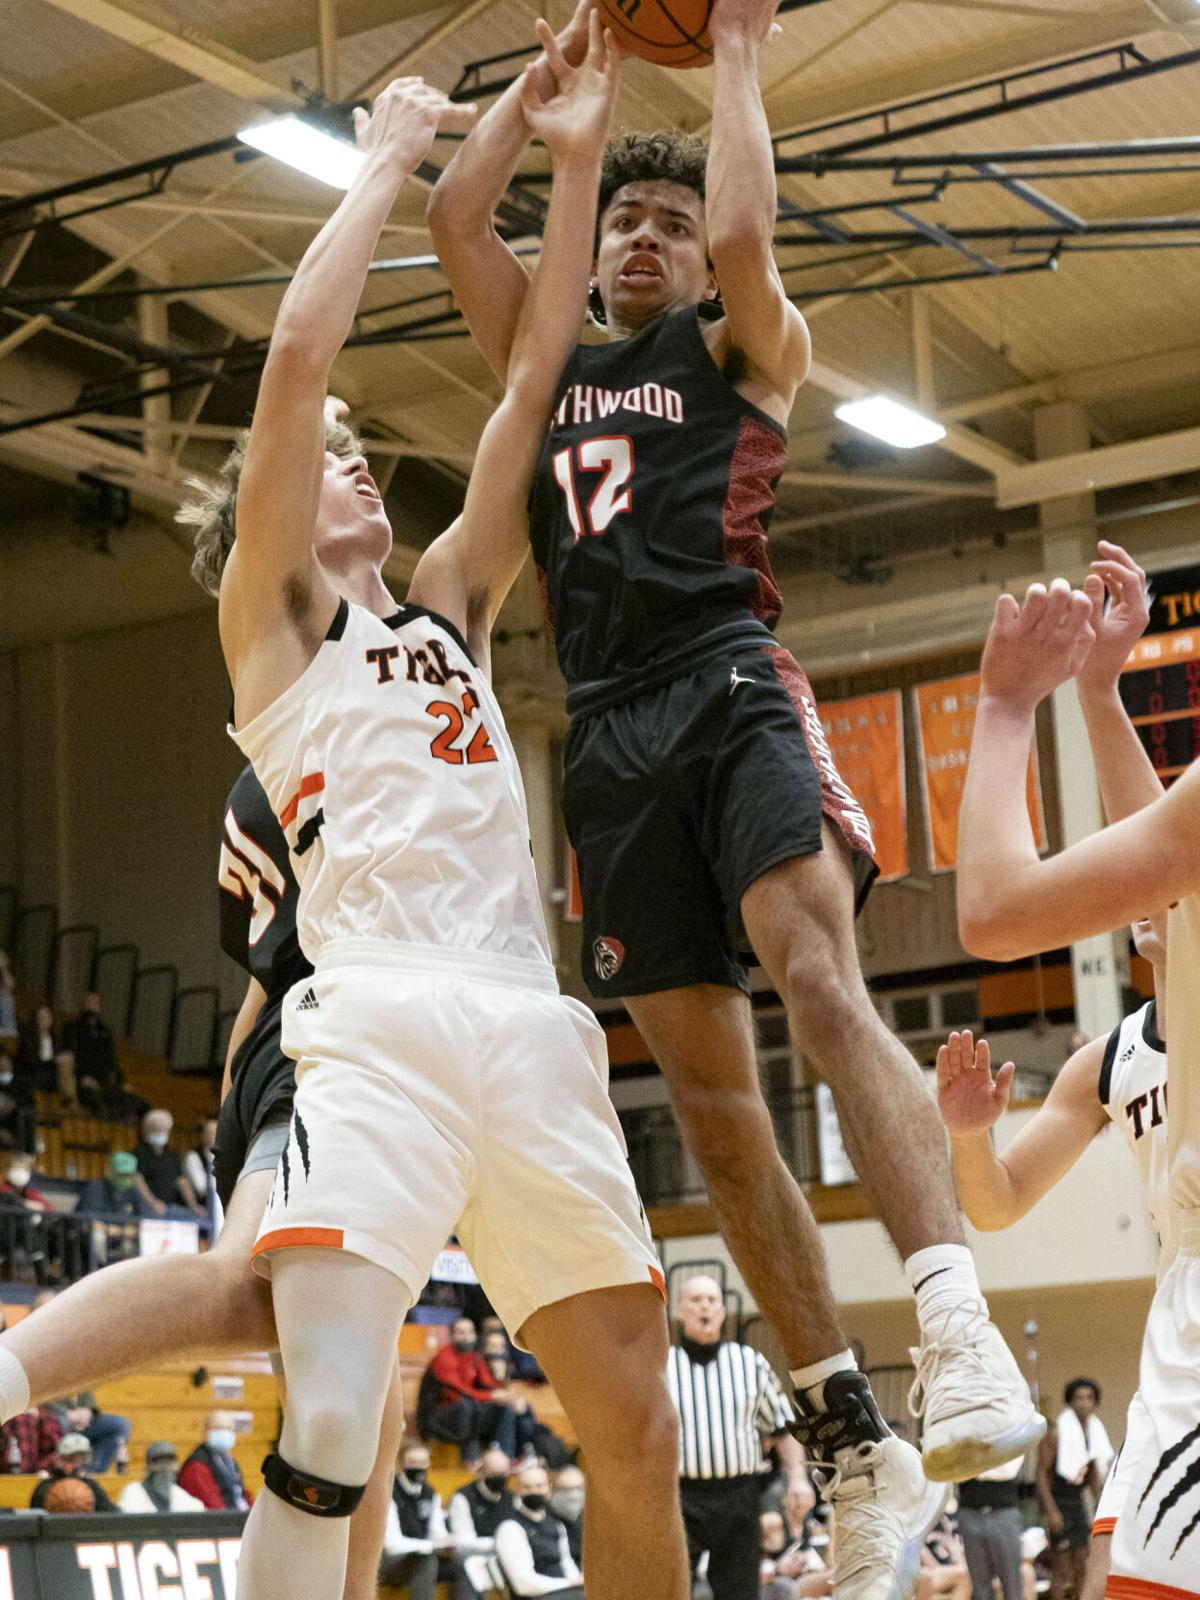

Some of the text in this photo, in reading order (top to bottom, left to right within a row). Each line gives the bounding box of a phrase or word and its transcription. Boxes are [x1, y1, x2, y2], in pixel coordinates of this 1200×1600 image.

[550, 382, 684, 430] THWOOD
[553, 434, 636, 545] 12
[425, 691, 499, 765] 22
[1125, 1081, 1168, 1140] TI
